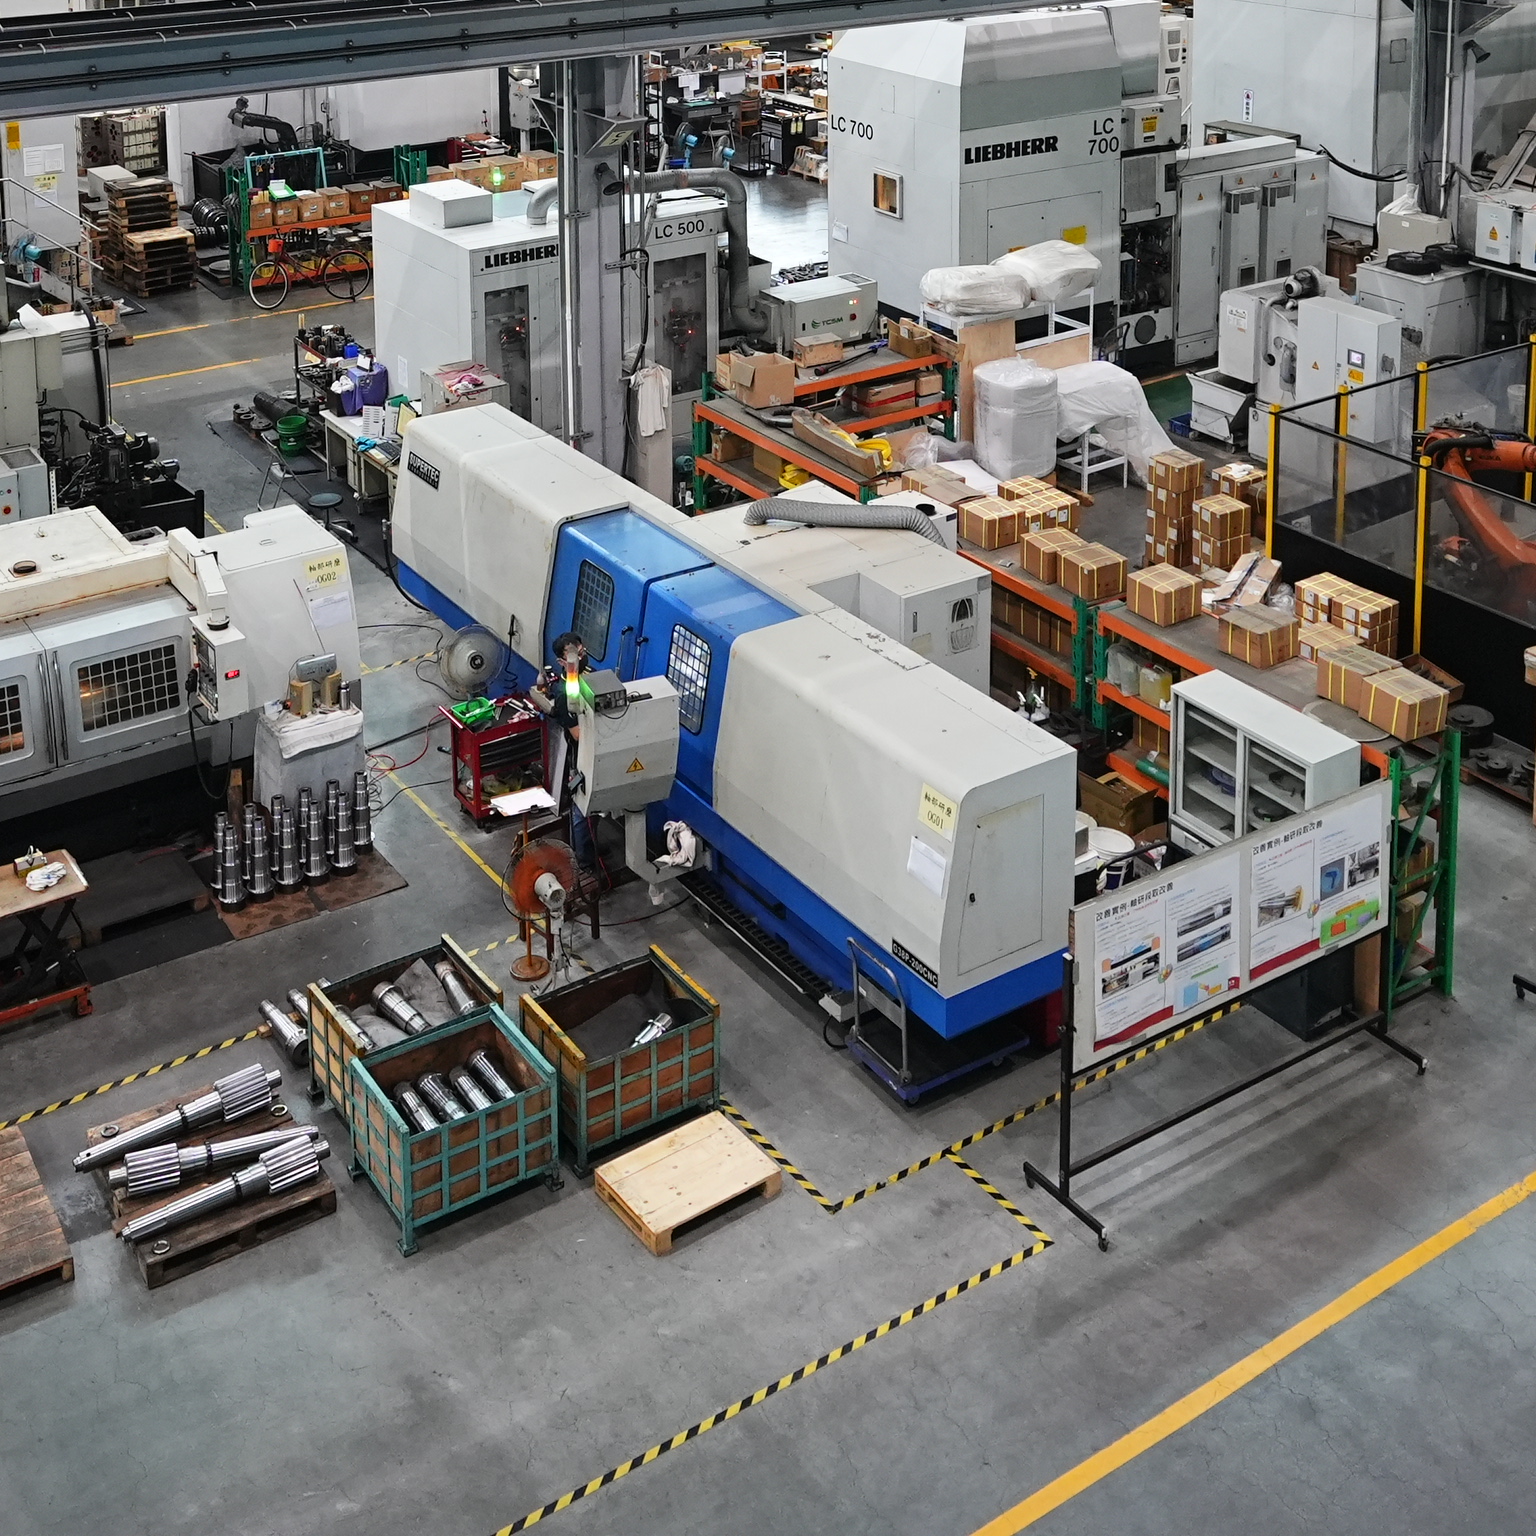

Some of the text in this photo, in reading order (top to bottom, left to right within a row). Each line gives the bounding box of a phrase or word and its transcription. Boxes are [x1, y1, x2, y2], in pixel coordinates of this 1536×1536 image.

[831, 115, 874, 141] LC 700
[1093, 117, 1115, 136] LC
[964, 135, 1059, 165] LIEBHERR
[1088, 137, 1120, 156] 700
[655, 219, 705, 240] LC 500
[484, 243, 559, 270] LIEBHER
[822, 317, 843, 326] TCSM
